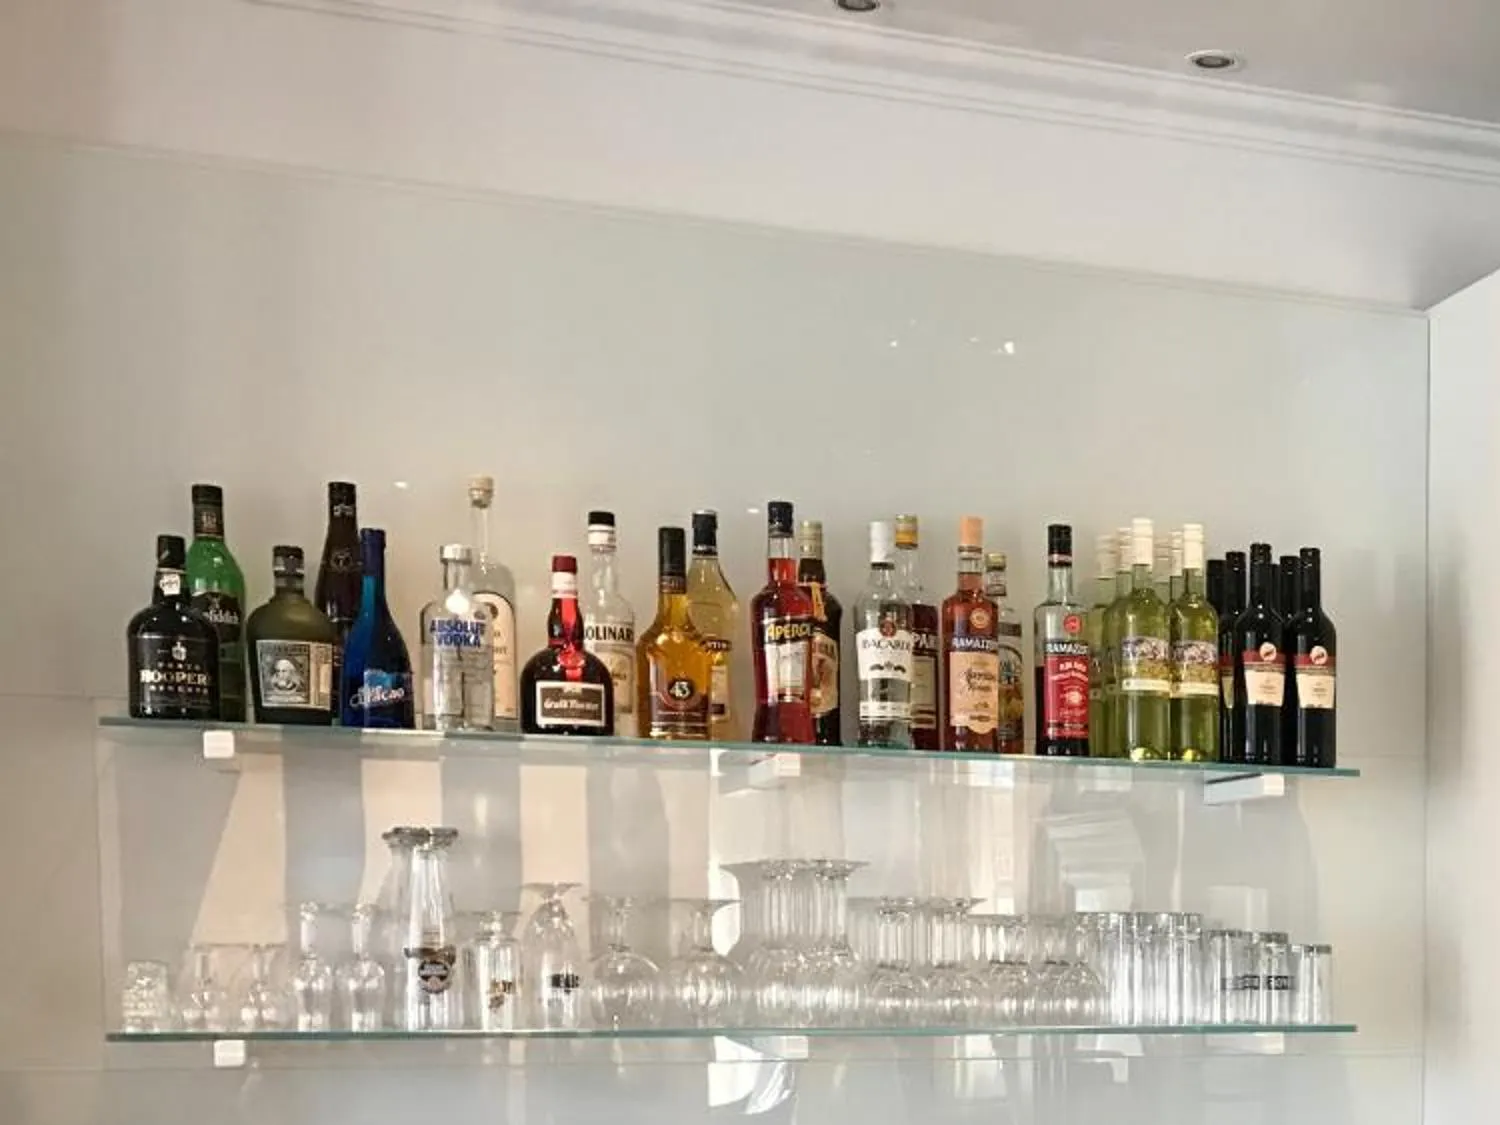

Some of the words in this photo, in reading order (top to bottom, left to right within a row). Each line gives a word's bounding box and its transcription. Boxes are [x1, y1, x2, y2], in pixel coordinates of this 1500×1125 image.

[430, 619, 486, 636] ABSOLUT
[584, 625, 634, 641] OLINAR
[437, 632, 481, 648] VODKA
[669, 678, 691, 698] 43
